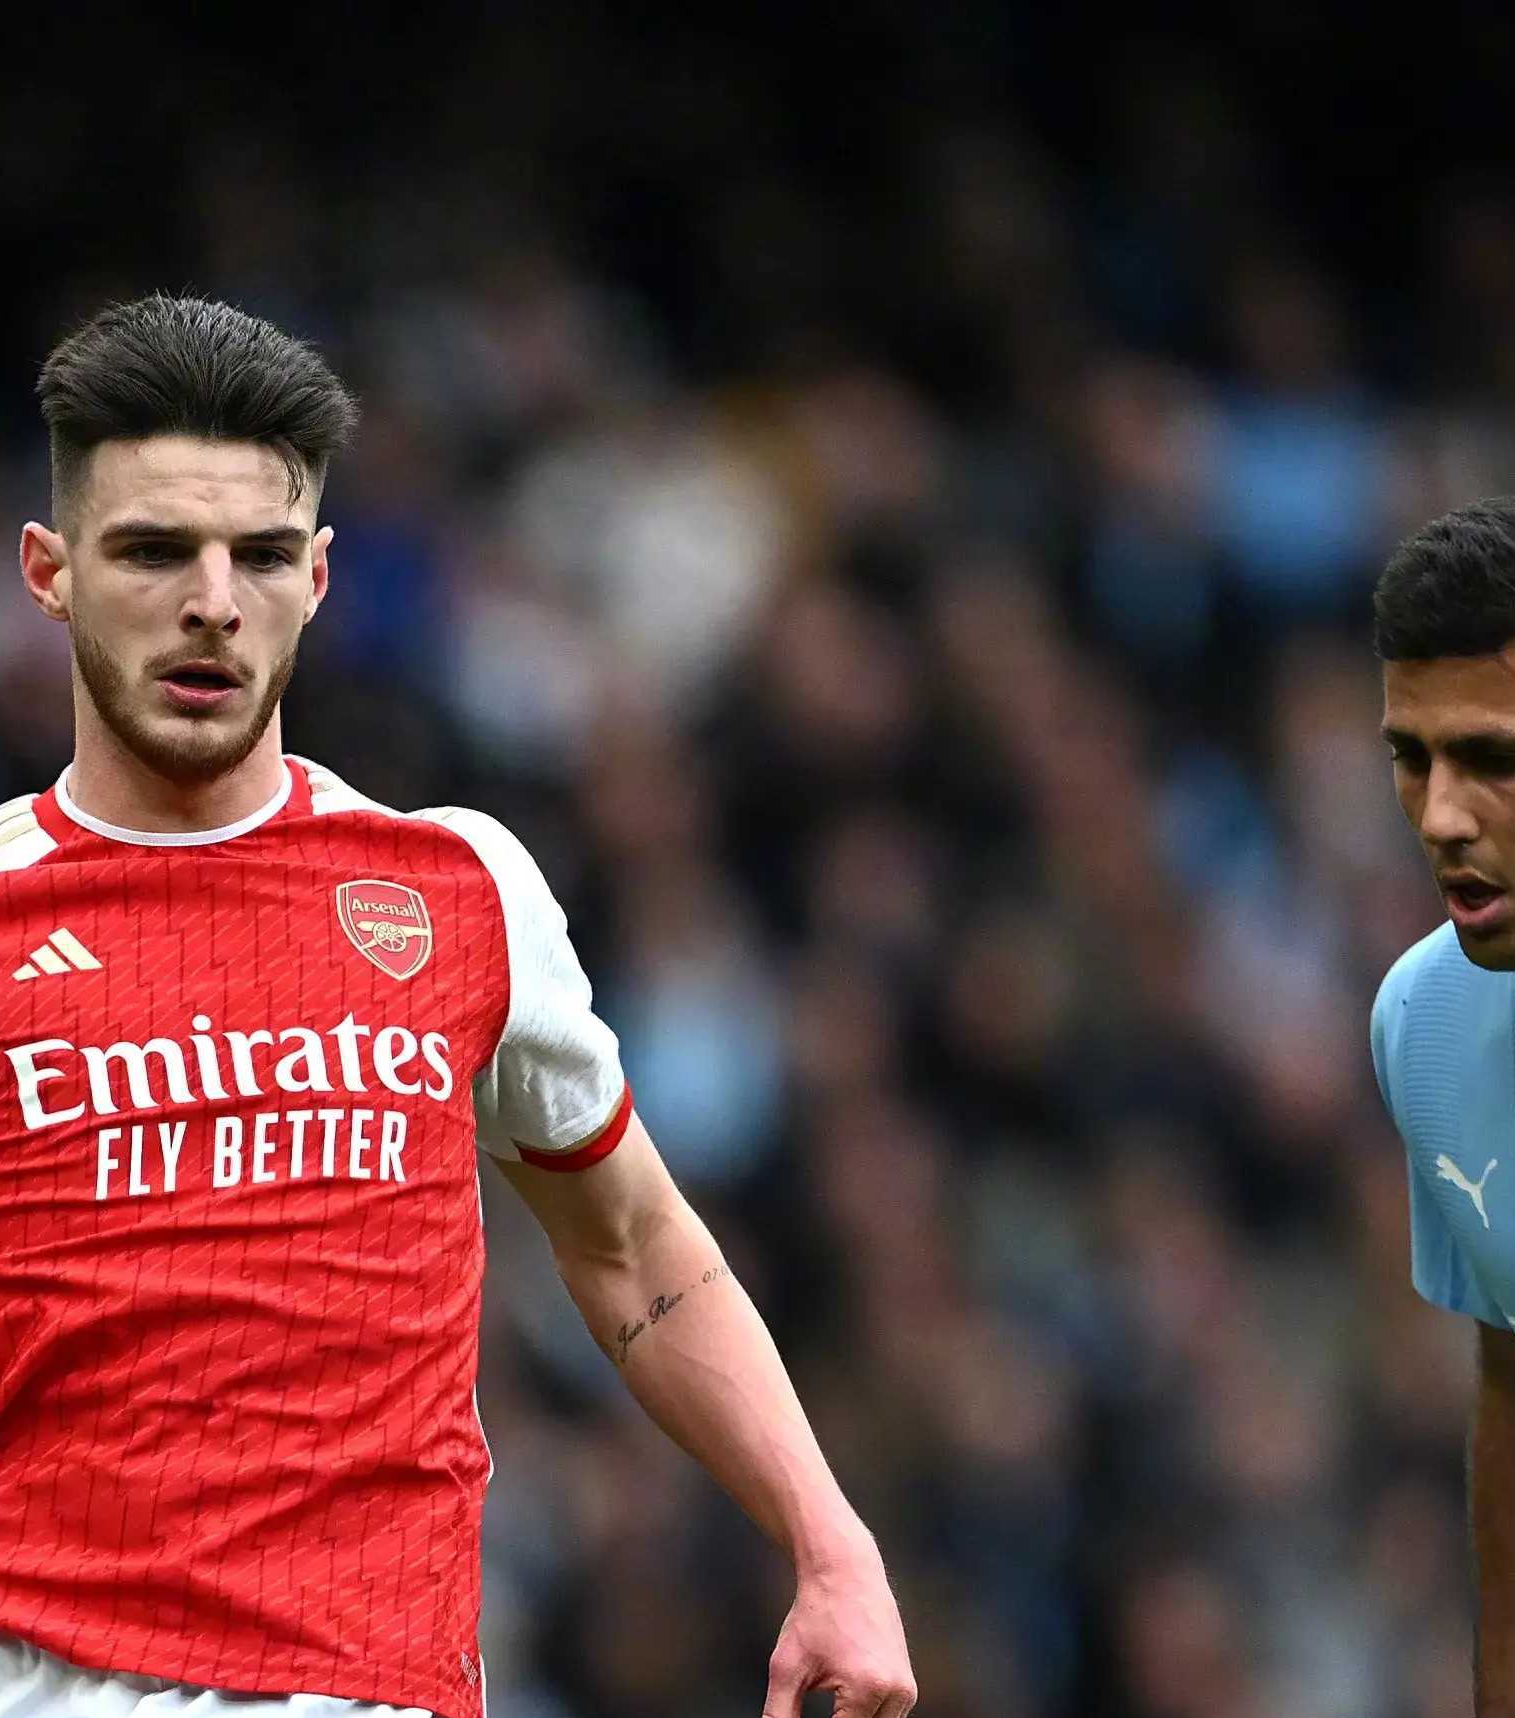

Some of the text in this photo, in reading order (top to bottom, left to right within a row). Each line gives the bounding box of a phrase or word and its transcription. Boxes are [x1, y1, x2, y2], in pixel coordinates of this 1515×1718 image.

[351, 897, 416, 918] Arsenal
[4, 1011, 454, 1131] Emirates
[95, 1108, 408, 1200] FLY BETTER
